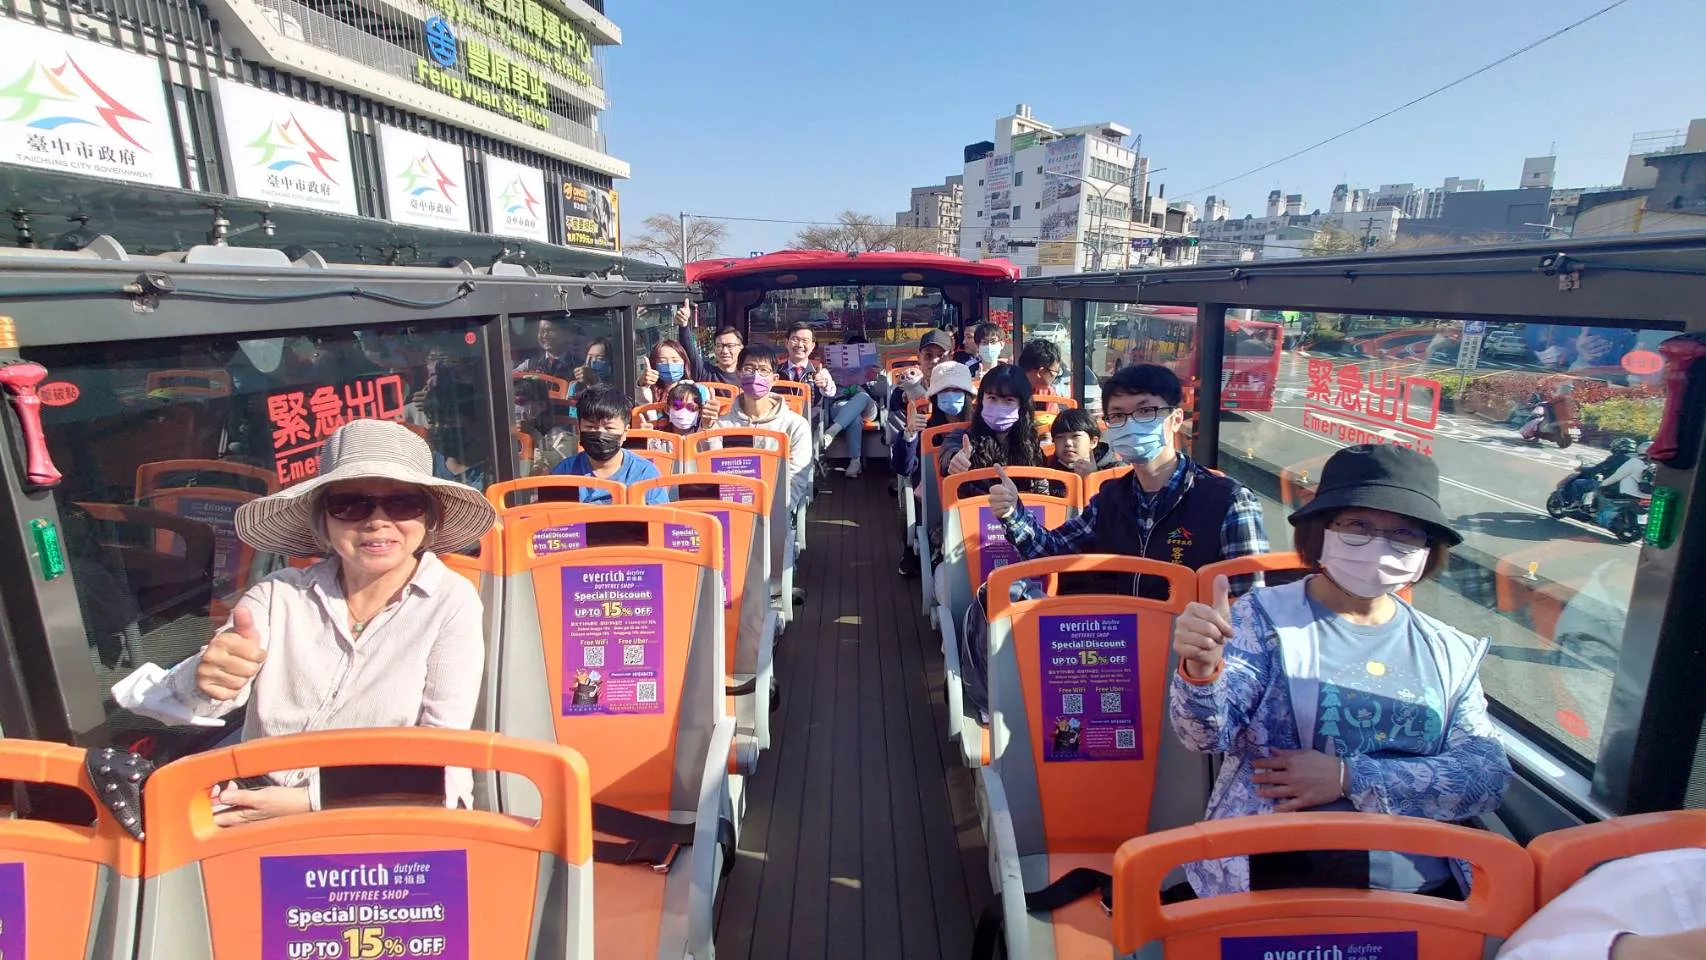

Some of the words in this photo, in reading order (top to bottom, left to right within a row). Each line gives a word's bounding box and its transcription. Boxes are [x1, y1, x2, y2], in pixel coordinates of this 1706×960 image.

[467, 37, 547, 107] 豐原車站
[554, 52, 593, 87] Station
[503, 94, 550, 129] Station
[16, 153, 69, 167] TAICHUNG
[70, 160, 92, 170] CITY
[26, 133, 136, 167] 臺中市政府
[1305, 357, 1441, 431] 緊急出口
[267, 374, 404, 449] 緊急出口
[583, 570, 625, 583] everrich
[574, 591, 607, 603] Special
[610, 590, 651, 600] Discount
[575, 608, 588, 617] UP
[588, 608, 601, 616] TO
[634, 607, 652, 616] OFF
[1060, 620, 1100, 632] everrich
[1052, 641, 1084, 651] Special
[1086, 640, 1126, 649] Discount
[1053, 657, 1064, 665] UP
[1064, 657, 1077, 665] TO
[1110, 656, 1126, 664] OFF
[305, 863, 388, 888] everrich
[393, 862, 430, 874] dutyfree
[328, 890, 380, 902] DUTYFREE
[382, 889, 409, 900] SHOP
[287, 906, 354, 929] Special
[359, 904, 443, 922] Discount
[288, 942, 313, 958] UP
[314, 941, 340, 957] TO
[342, 926, 404, 959] 15%
[408, 937, 444, 954] OFF
